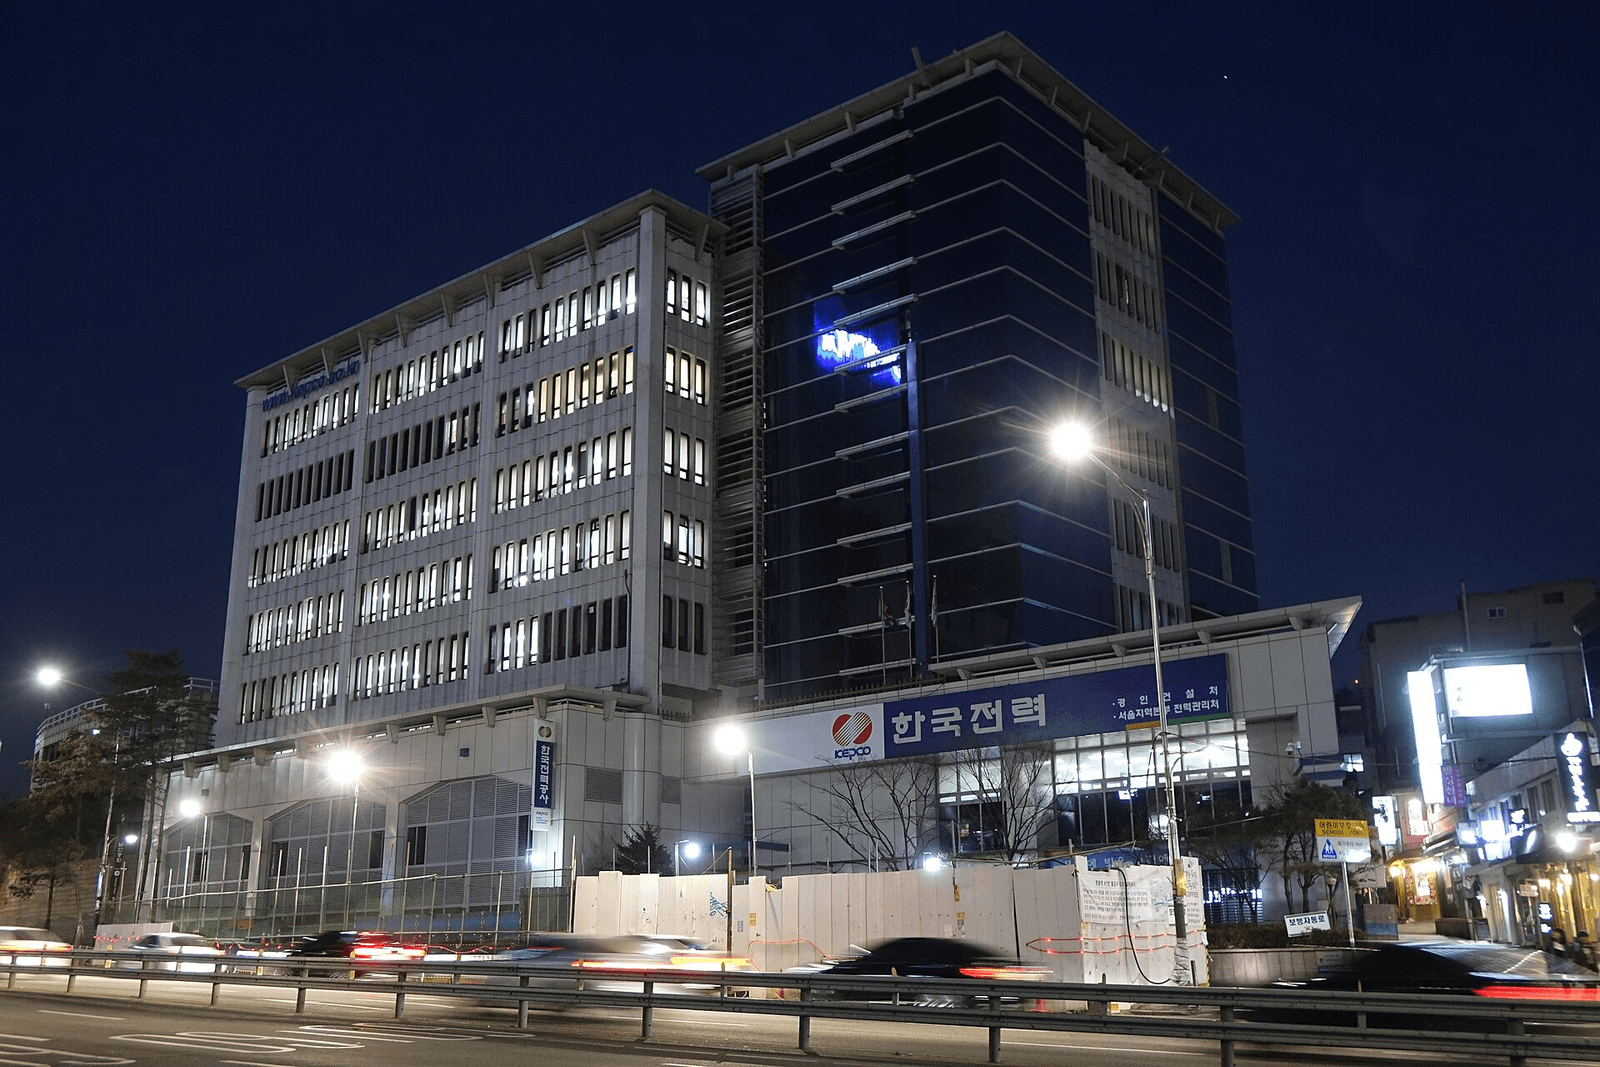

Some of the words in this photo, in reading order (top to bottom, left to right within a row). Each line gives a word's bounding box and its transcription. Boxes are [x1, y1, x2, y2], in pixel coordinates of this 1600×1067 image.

[1173, 699, 1220, 714] 전력관리처
[892, 693, 1047, 745] 한국전력
[834, 745, 872, 761] KEPCO
[538, 744, 551, 806] 한국전력공사
[1288, 915, 1326, 927] 보행자통로
